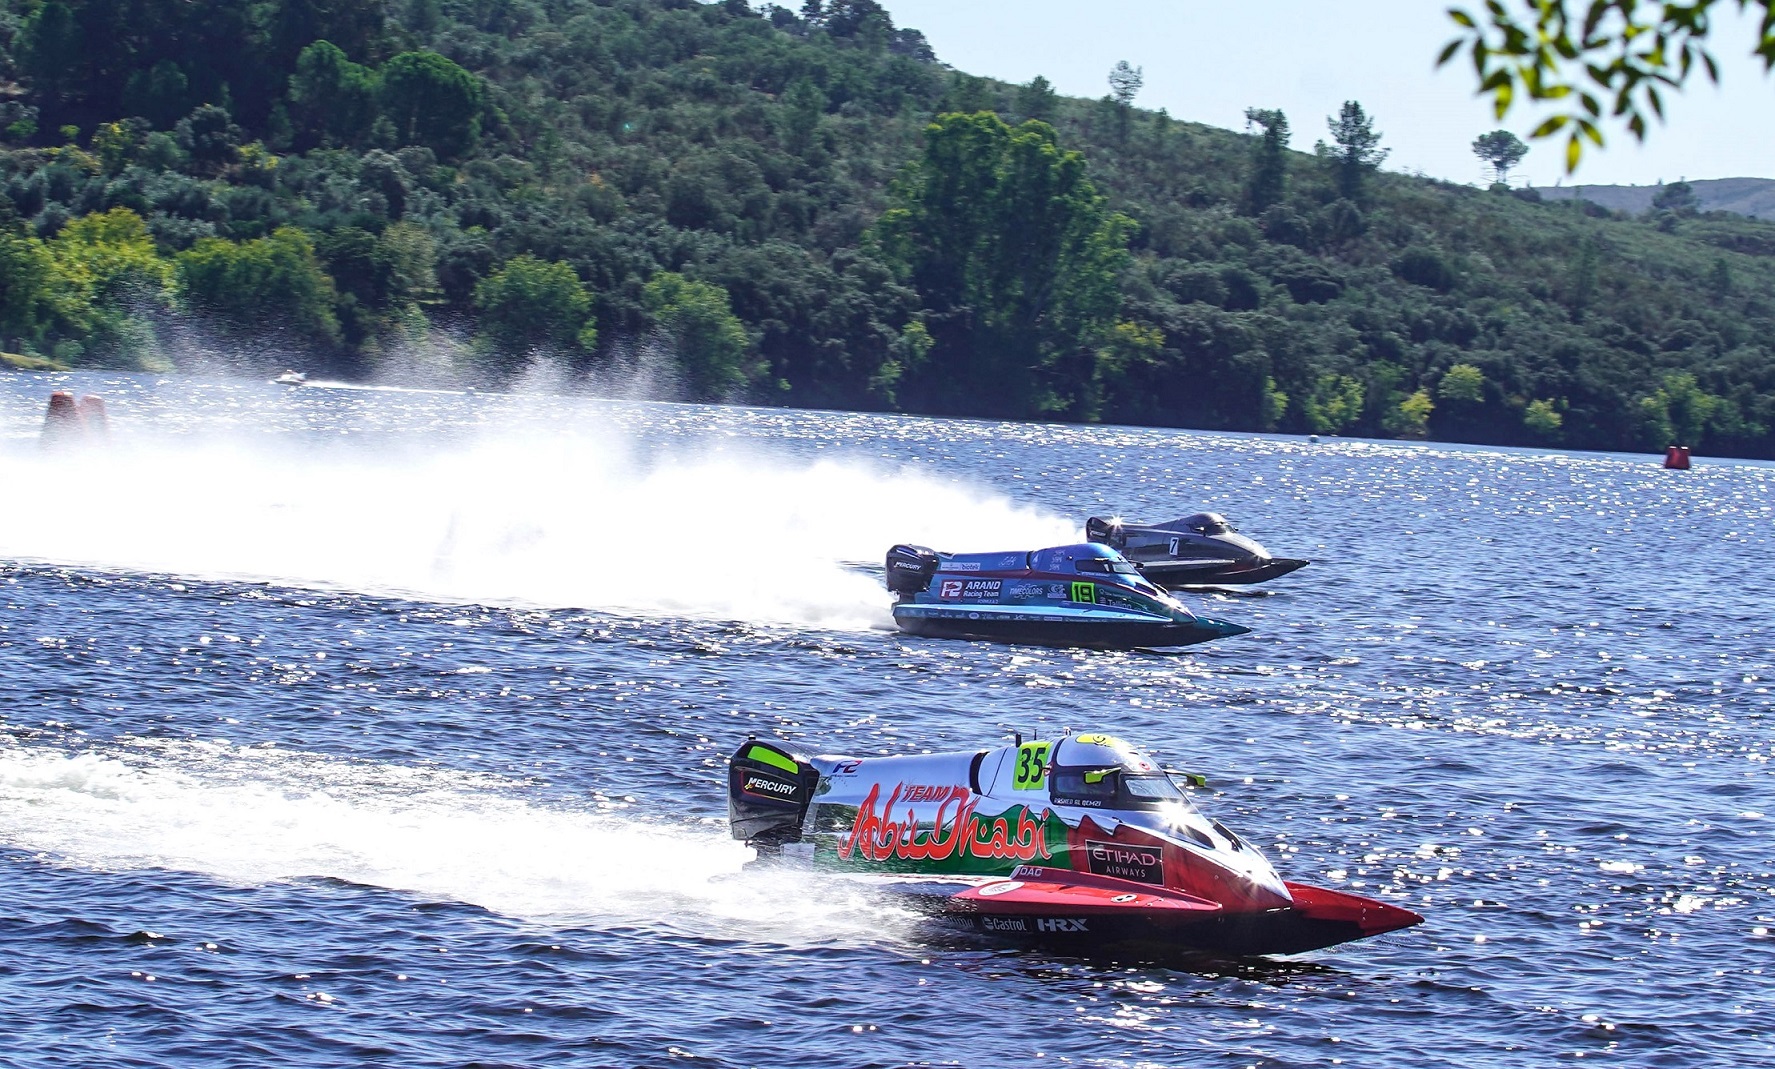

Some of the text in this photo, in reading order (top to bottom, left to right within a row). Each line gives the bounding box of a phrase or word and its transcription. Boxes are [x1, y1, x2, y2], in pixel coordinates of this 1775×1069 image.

[1170, 538, 1178, 554] 7
[894, 561, 921, 570] MERCURY
[941, 581, 962, 597] F2
[965, 581, 1001, 590] ARAND
[1073, 583, 1093, 602] 19
[963, 590, 982, 598] Racing
[833, 760, 863, 774] F2
[1017, 747, 1046, 784] 35
[745, 777, 797, 795] MERCURY
[901, 784, 950, 802] TEAM
[837, 781, 1052, 861] Abu Dhabi
[1093, 848, 1156, 866] ETIHAD
[1106, 866, 1146, 878] AIRWAYS
[993, 917, 1026, 931] Castrol
[1037, 918, 1089, 932] HRX
